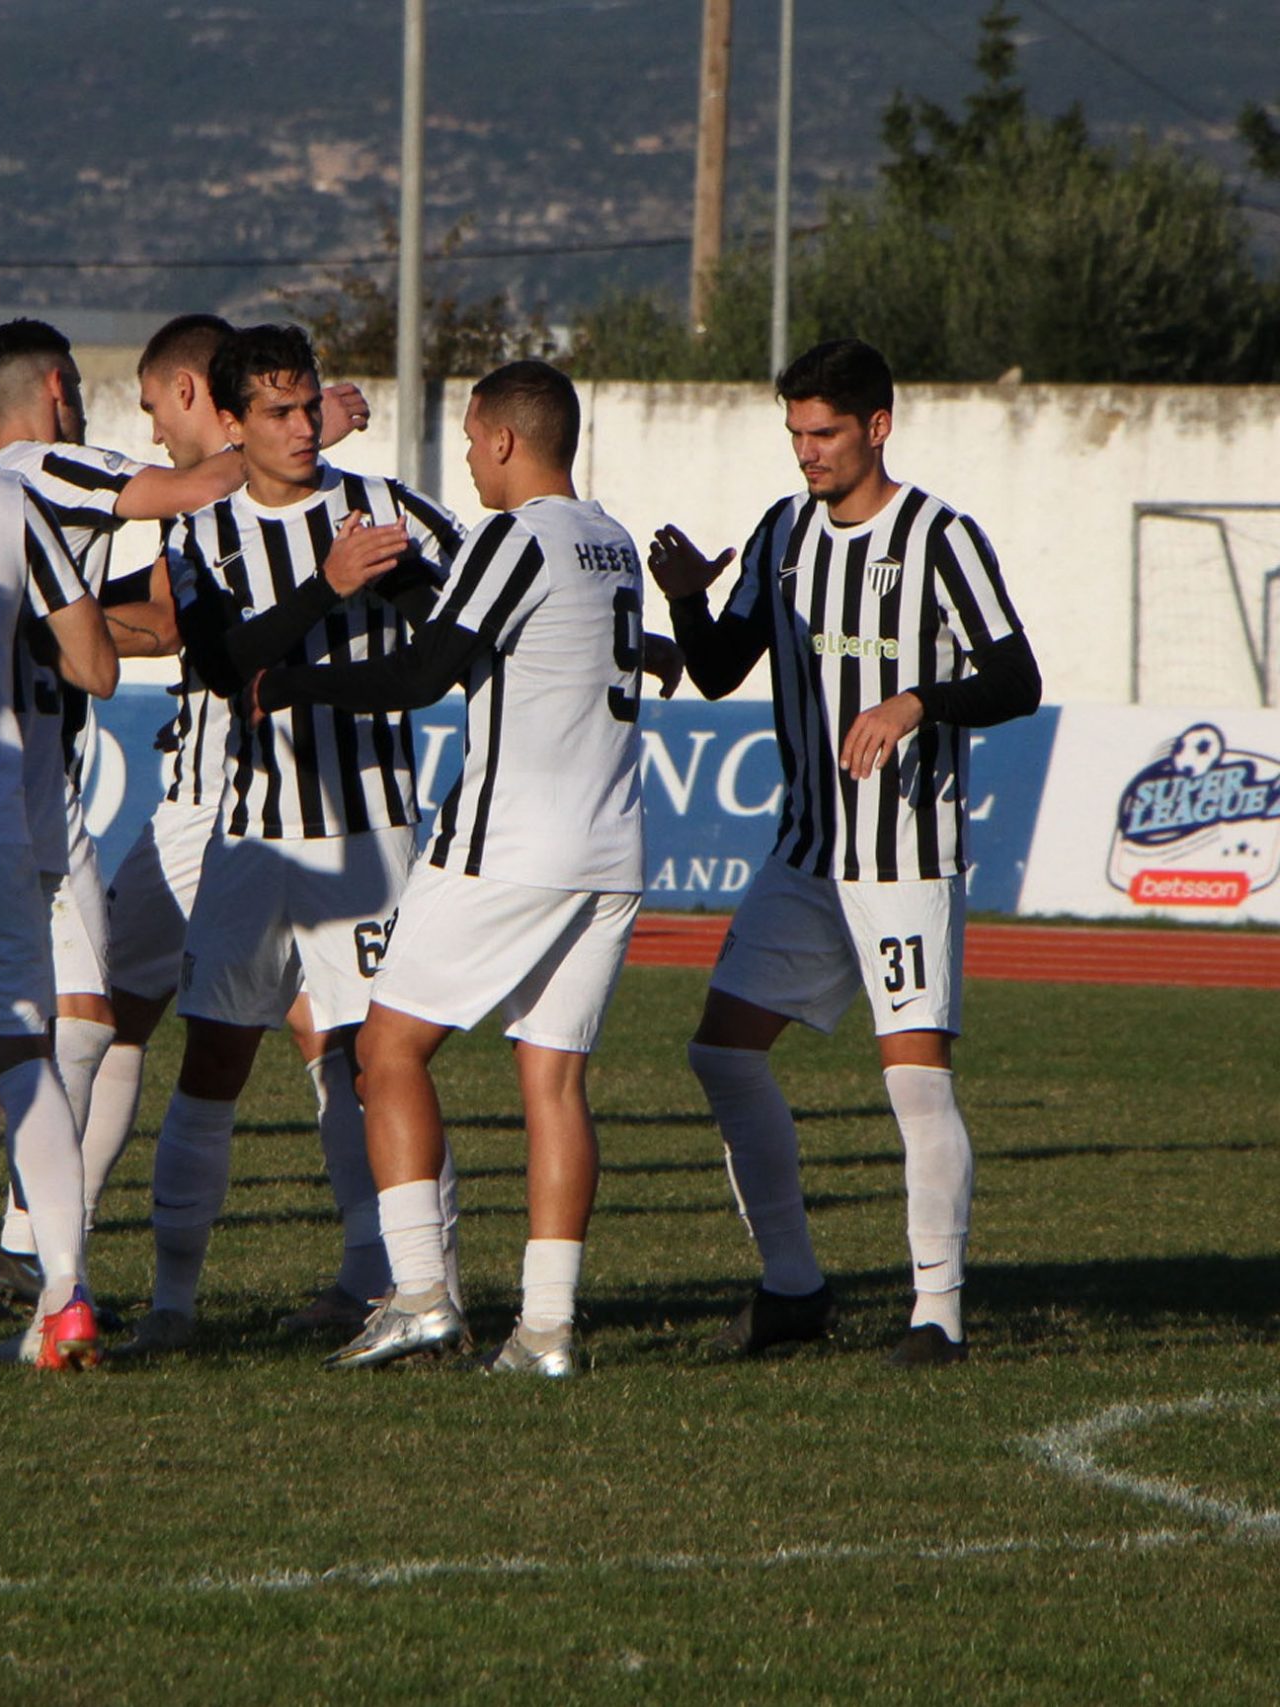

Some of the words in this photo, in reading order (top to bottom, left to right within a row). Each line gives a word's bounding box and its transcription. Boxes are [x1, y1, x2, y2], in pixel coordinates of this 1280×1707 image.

[575, 543, 639, 574] HEBE
[809, 631, 899, 660] olterra
[1136, 766, 1248, 808] SUPER
[1124, 785, 1270, 835] LEAGUE
[649, 857, 751, 892] AND
[1139, 874, 1239, 899] betsson
[880, 934, 926, 993] 31
